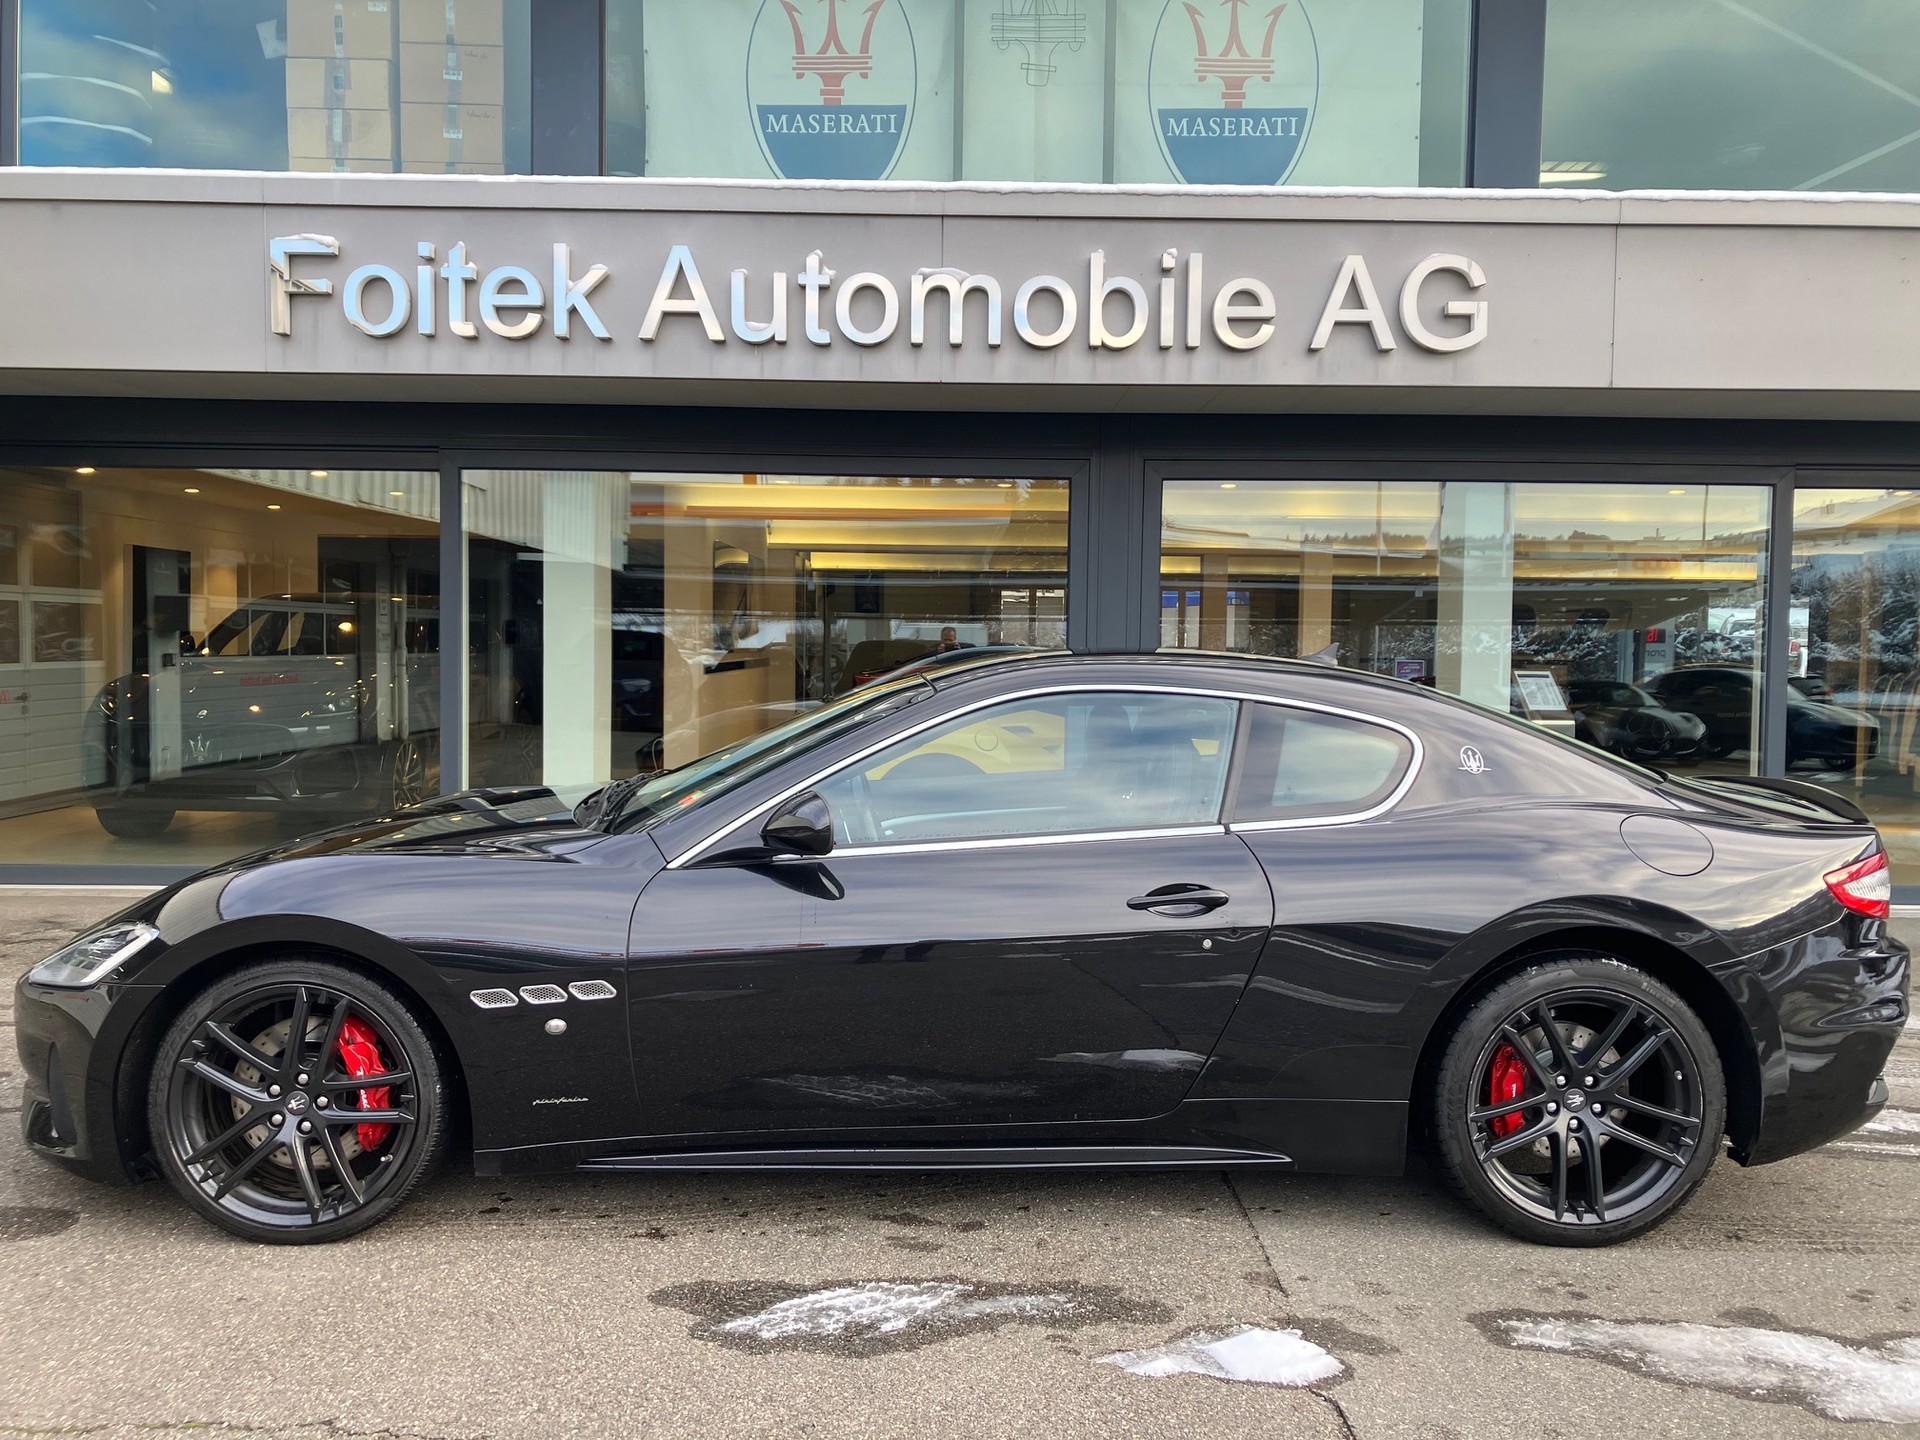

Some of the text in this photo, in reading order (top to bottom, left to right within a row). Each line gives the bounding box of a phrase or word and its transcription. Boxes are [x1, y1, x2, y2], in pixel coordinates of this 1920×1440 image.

[765, 113, 898, 134] MASERATI
[1166, 116, 1299, 137] MASERATI
[270, 233, 1489, 353] Foitek Automobile AG
[532, 1096, 589, 1106] pininfarina
